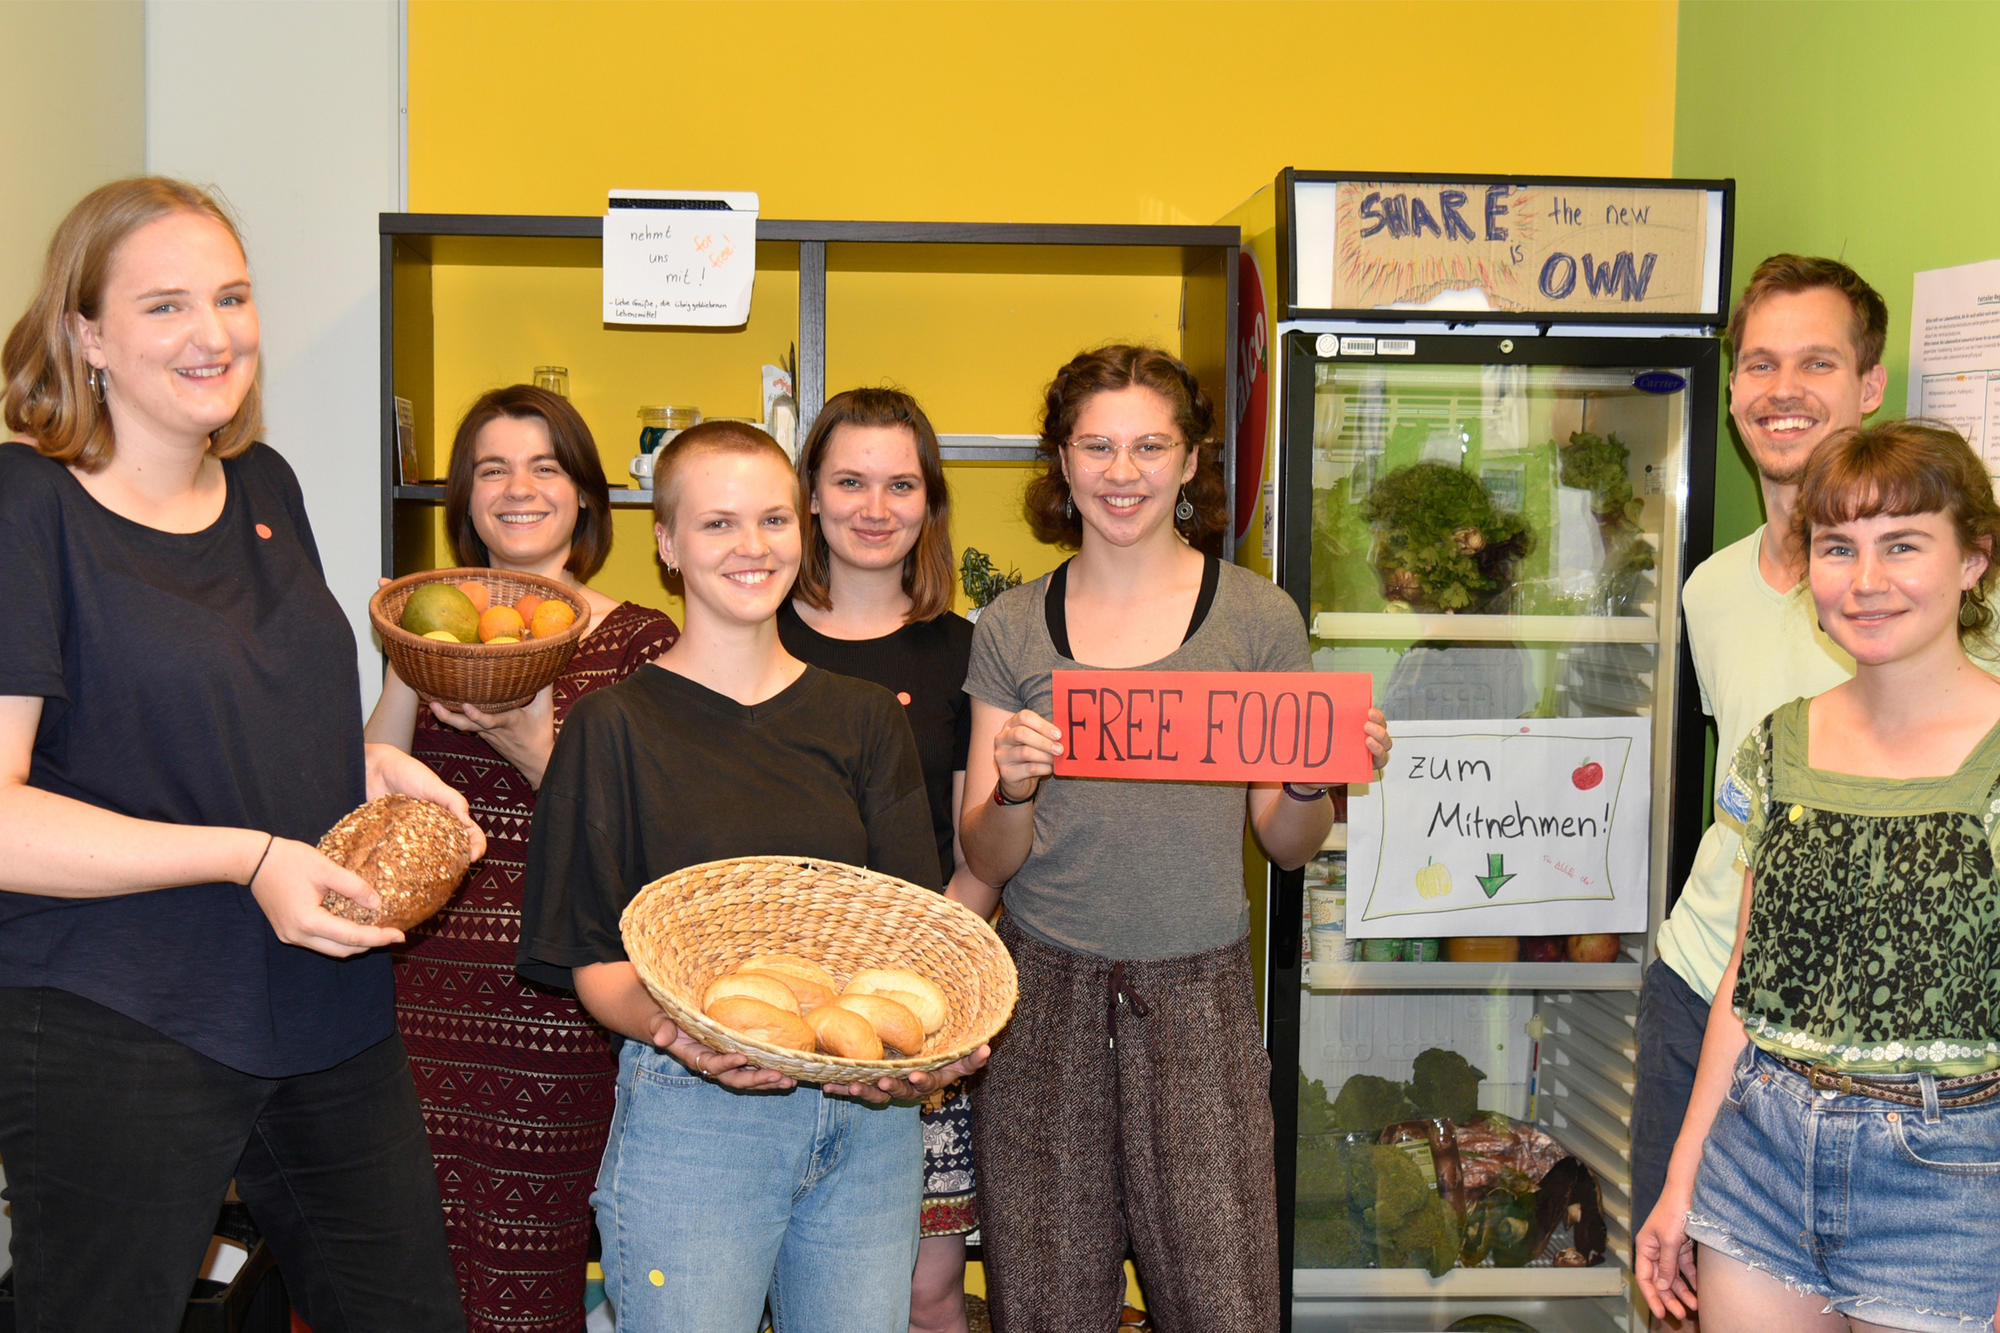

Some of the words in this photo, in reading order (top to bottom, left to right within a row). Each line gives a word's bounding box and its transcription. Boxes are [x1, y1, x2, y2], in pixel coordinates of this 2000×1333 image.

[1359, 185, 1509, 243] SHARE
[1548, 196, 1582, 226] the
[1606, 205, 1651, 226] new
[630, 224, 672, 241] nehmt
[649, 253, 669, 263] uns
[1510, 239, 1524, 265] is
[1538, 251, 1658, 302] OWN
[1065, 688, 1183, 762] FREE
[1200, 690, 1334, 768] FOOD
[1427, 800, 1609, 839] Mitnehmen!
